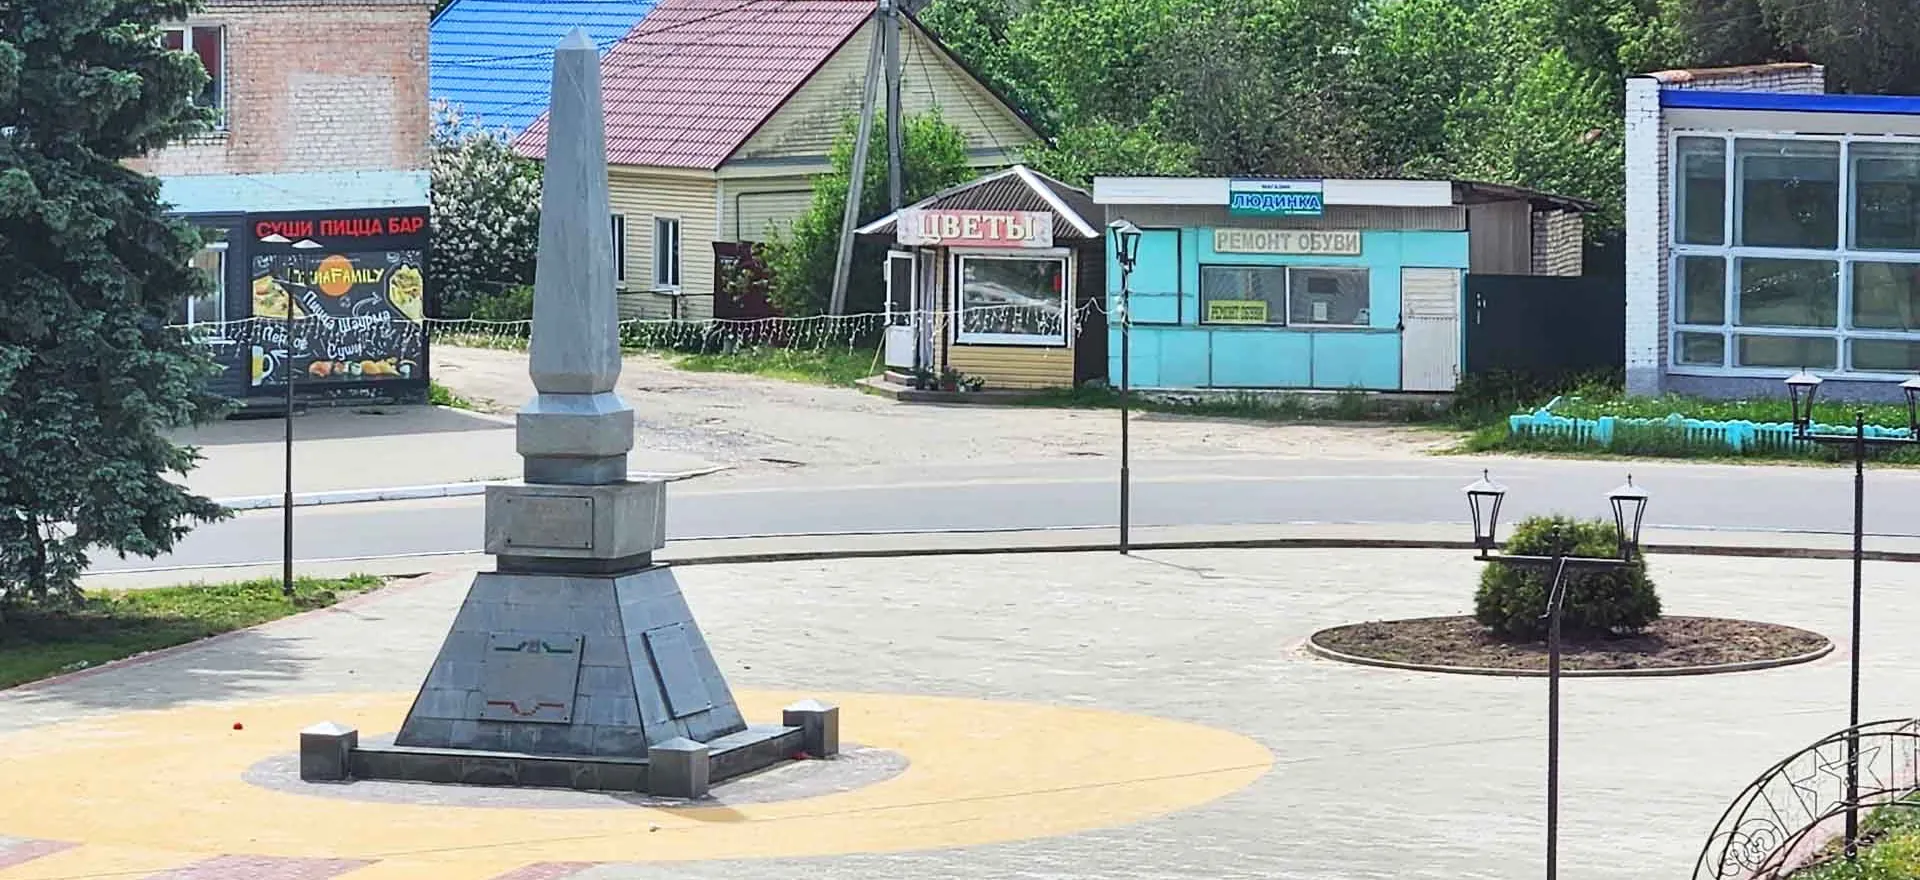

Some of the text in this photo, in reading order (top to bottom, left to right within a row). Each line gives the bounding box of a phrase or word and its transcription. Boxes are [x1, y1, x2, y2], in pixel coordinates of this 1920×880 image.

[1231, 193, 1321, 211] ЛЮДИНКА
[255, 216, 424, 237] СУШИ ПИЦЦА БАР
[917, 213, 1038, 245] ЦВЕТЫ
[1217, 231, 1358, 252] РЕМОНТ ОБУВИ
[303, 290, 391, 333] Пицца Шаурма
